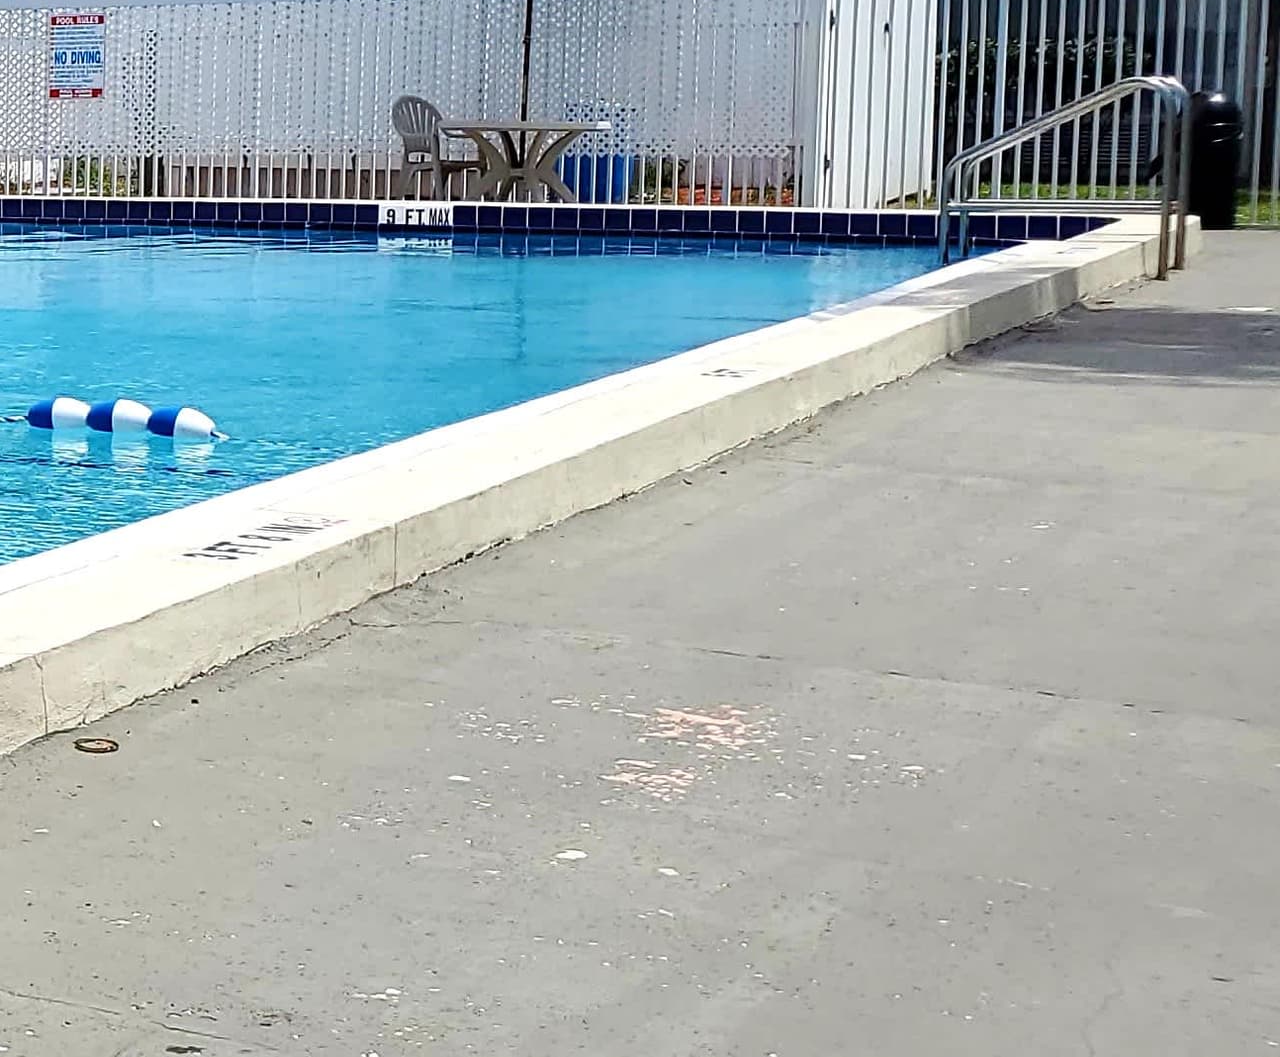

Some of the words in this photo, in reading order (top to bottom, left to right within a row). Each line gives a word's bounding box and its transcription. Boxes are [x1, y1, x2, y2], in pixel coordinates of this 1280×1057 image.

[56, 16, 75, 25] POOL
[54, 51, 68, 65] NO
[71, 50, 101, 65] DIVING
[386, 208, 396, 224] 9
